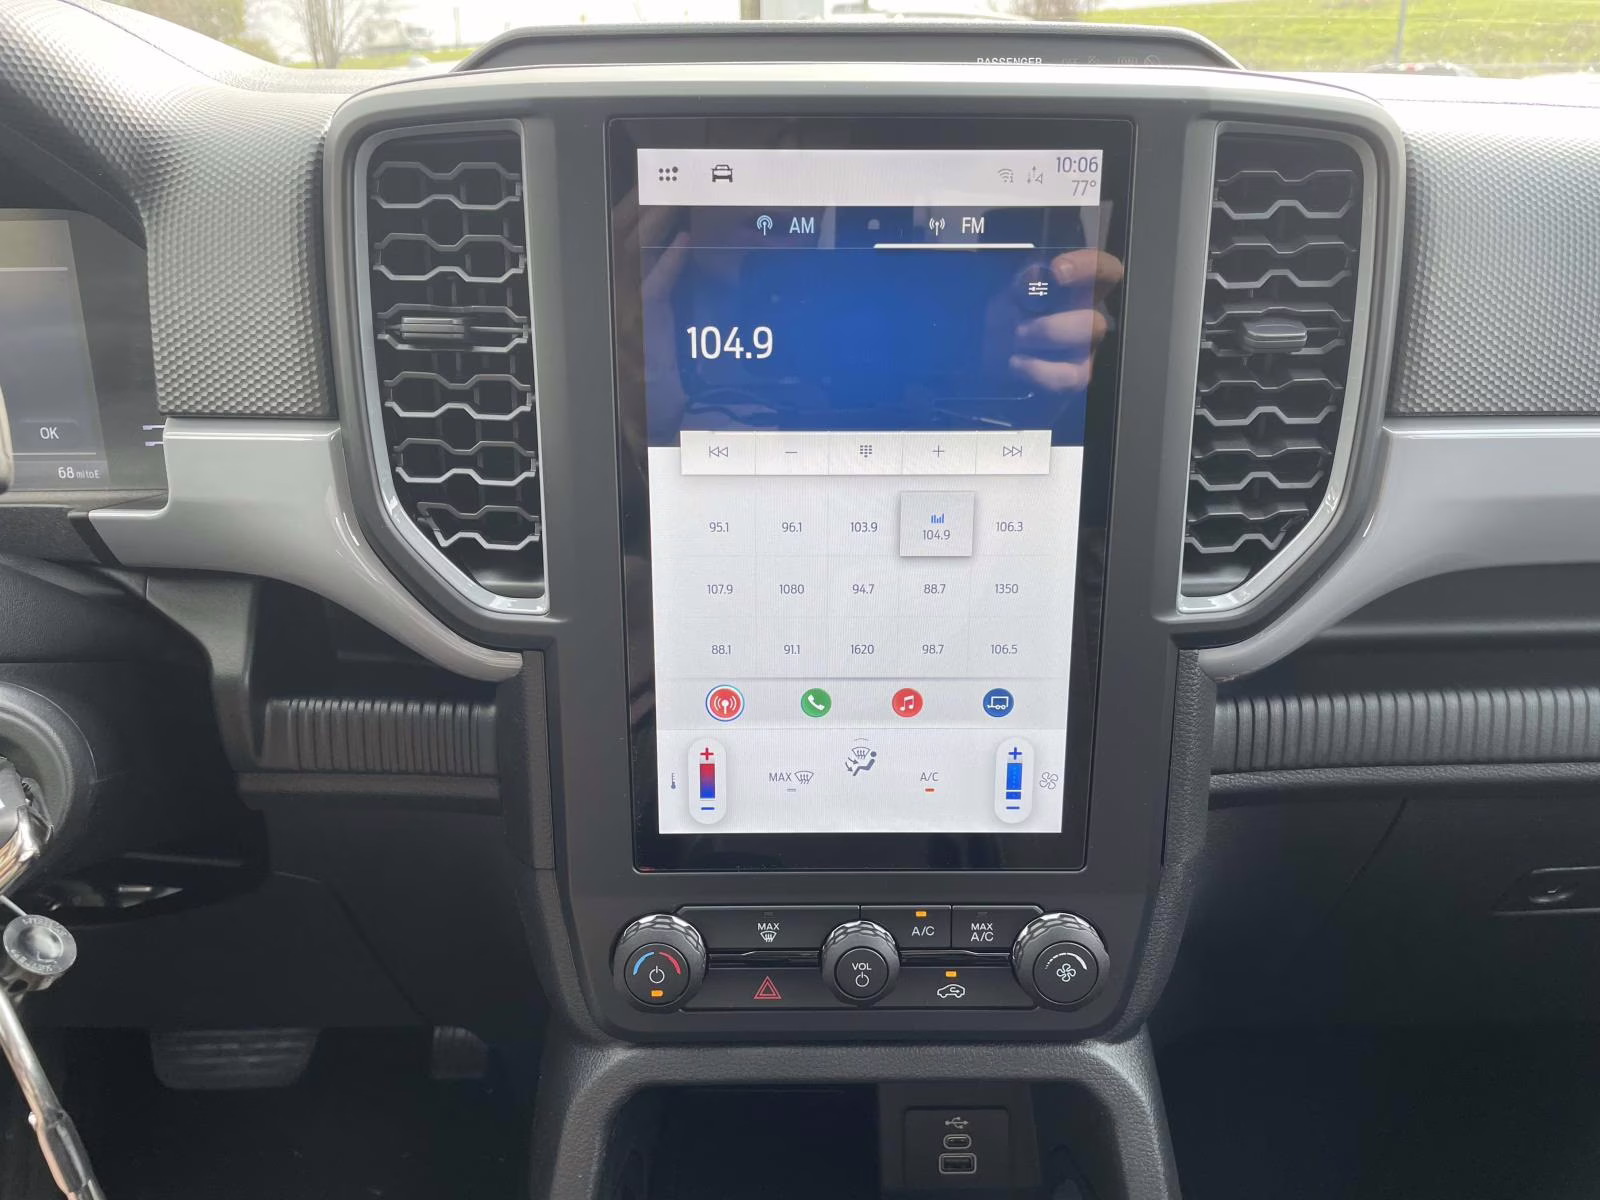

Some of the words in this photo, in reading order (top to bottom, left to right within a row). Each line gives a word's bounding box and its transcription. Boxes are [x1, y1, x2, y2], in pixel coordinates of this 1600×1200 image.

[1056, 156, 1099, 174] 10:06
[788, 216, 815, 234] AM
[961, 216, 985, 234] FM
[686, 325, 773, 360] 104.9
[39, 426, 60, 440] OK
[58, 466, 75, 479] 68
[709, 521, 729, 533] 95.1
[781, 521, 802, 533] 96.1
[850, 521, 878, 533] 103.9
[996, 521, 1024, 533] 106.3
[922, 529, 951, 541] 104.9
[706, 583, 734, 595] 107.9
[779, 583, 805, 595] 1080
[852, 583, 875, 595] 94.7
[923, 583, 946, 595] 88.7
[994, 583, 1019, 594] 1350
[711, 644, 732, 655] 88.1
[783, 644, 801, 655] 91.1
[850, 644, 875, 655] 1620
[922, 643, 945, 655] 98.7
[990, 643, 1018, 655] 106.5
[768, 772, 792, 782] MAX
[919, 771, 939, 782] A/C
[757, 922, 780, 931] MAX
[911, 925, 935, 937] A/C
[970, 922, 994, 931] MAX
[970, 931, 994, 942] A/C
[851, 962, 872, 971] VOL
